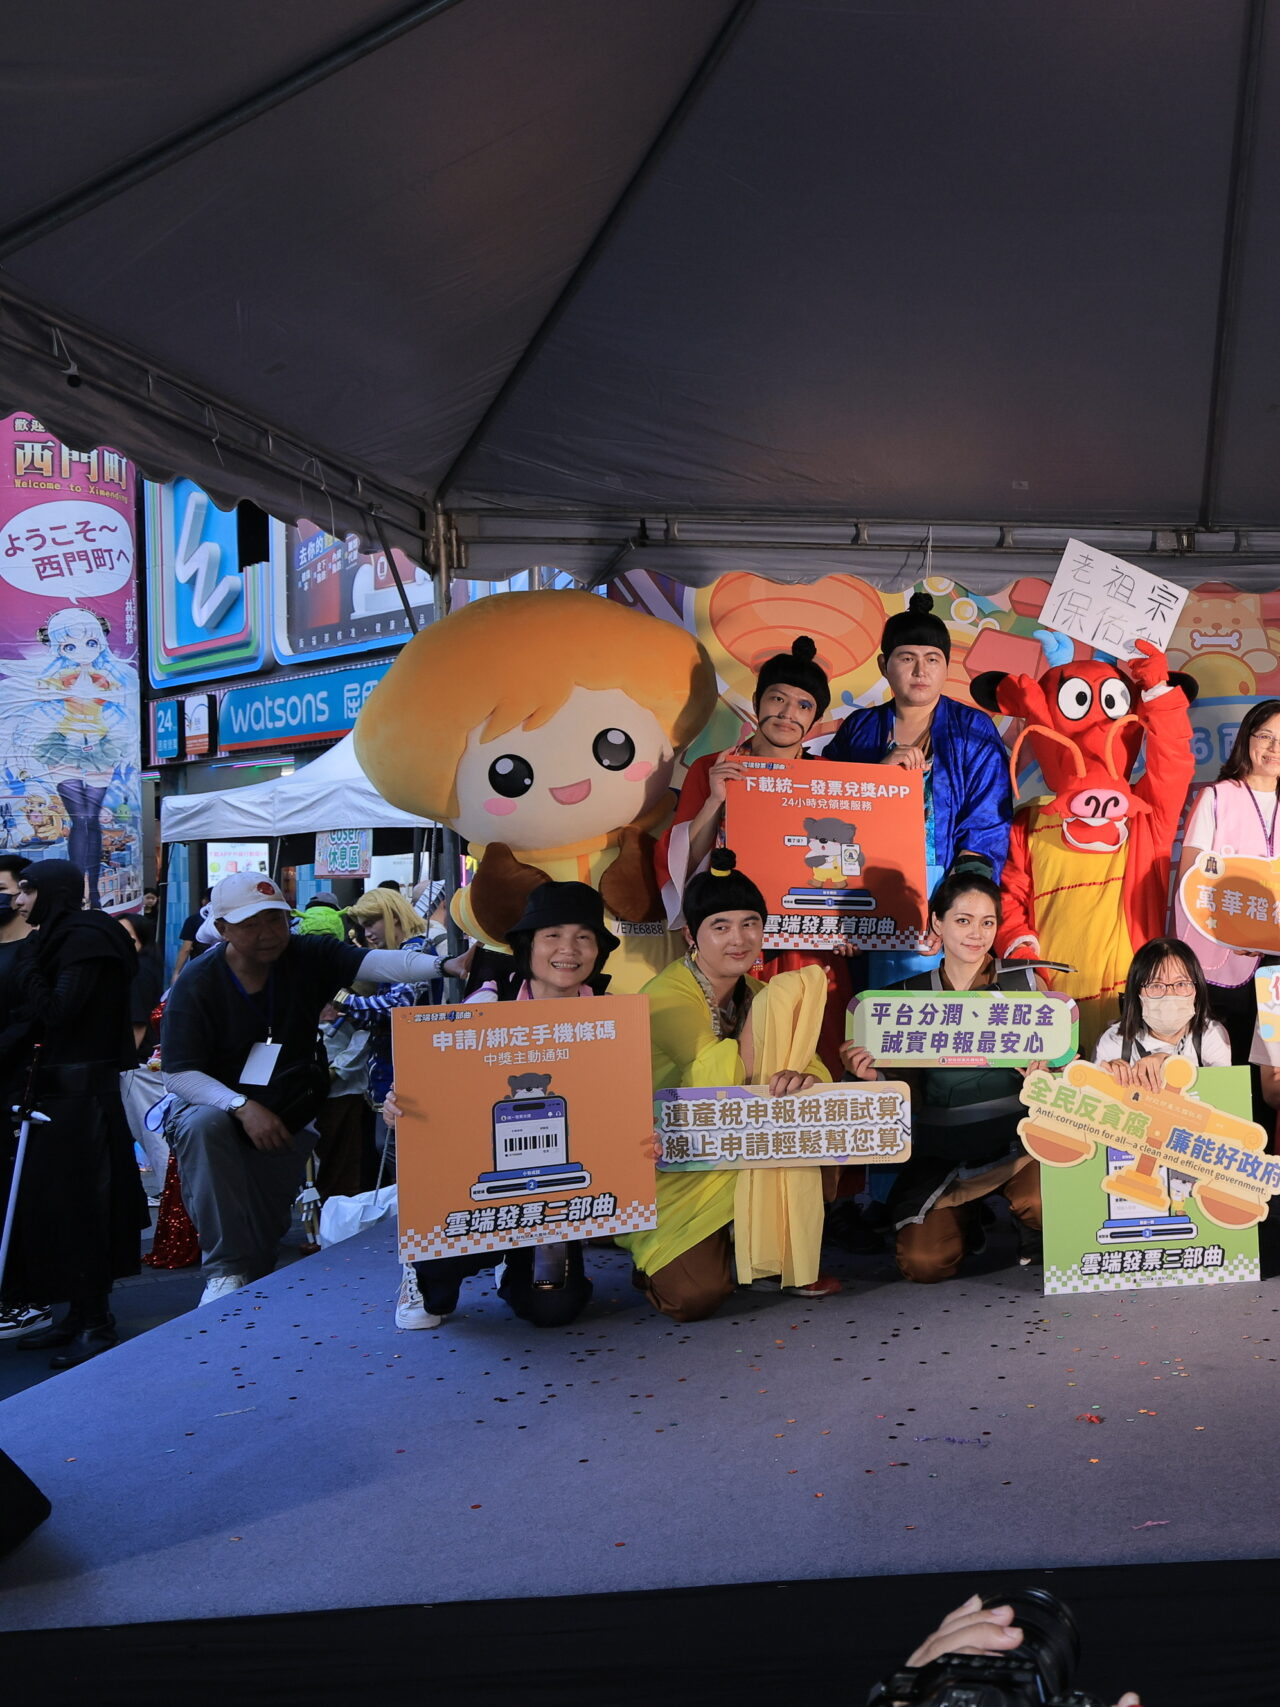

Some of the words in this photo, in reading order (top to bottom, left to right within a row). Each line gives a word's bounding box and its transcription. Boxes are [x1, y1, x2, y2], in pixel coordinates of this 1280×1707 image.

[14, 440, 128, 490] 西門町
[14, 478, 61, 490] Welcome
[69, 483, 82, 492] to
[89, 486, 128, 504] Ximending
[32, 548, 130, 581] 西門町へ
[1071, 554, 1180, 623] 老祖宗
[157, 708, 173, 733] 24
[230, 691, 329, 734] watsons
[745, 776, 910, 798] 下載統一發票兌獎APP
[781, 797, 872, 811] 24小時兌領獎服務
[328, 846, 360, 871] 休息區
[763, 914, 896, 935] 雲端發票首部曲
[870, 1002, 1056, 1027] 平台分潤、業配金
[432, 1020, 616, 1051] 申請/綁定手機條碼
[880, 1030, 1045, 1054] 誠實申報最安心
[483, 1048, 570, 1067] 中獎主動通知
[664, 1095, 901, 1128] 遺產稅申報稅額試算
[1026, 1077, 1151, 1139] 全民反貪腐
[664, 1126, 901, 1160] 線上申請輕鬆幫您算
[1035, 1107, 1100, 1136] Anti-corruption
[1101, 1129, 1114, 1140] for
[1139, 1144, 1162, 1158] clean
[1162, 1152, 1180, 1164] and
[1180, 1159, 1214, 1177] efficient
[1214, 1172, 1267, 1196] government.
[446, 1194, 617, 1237] 雲端發票二部曲
[1081, 1246, 1224, 1275] 雲端發票三部曲
